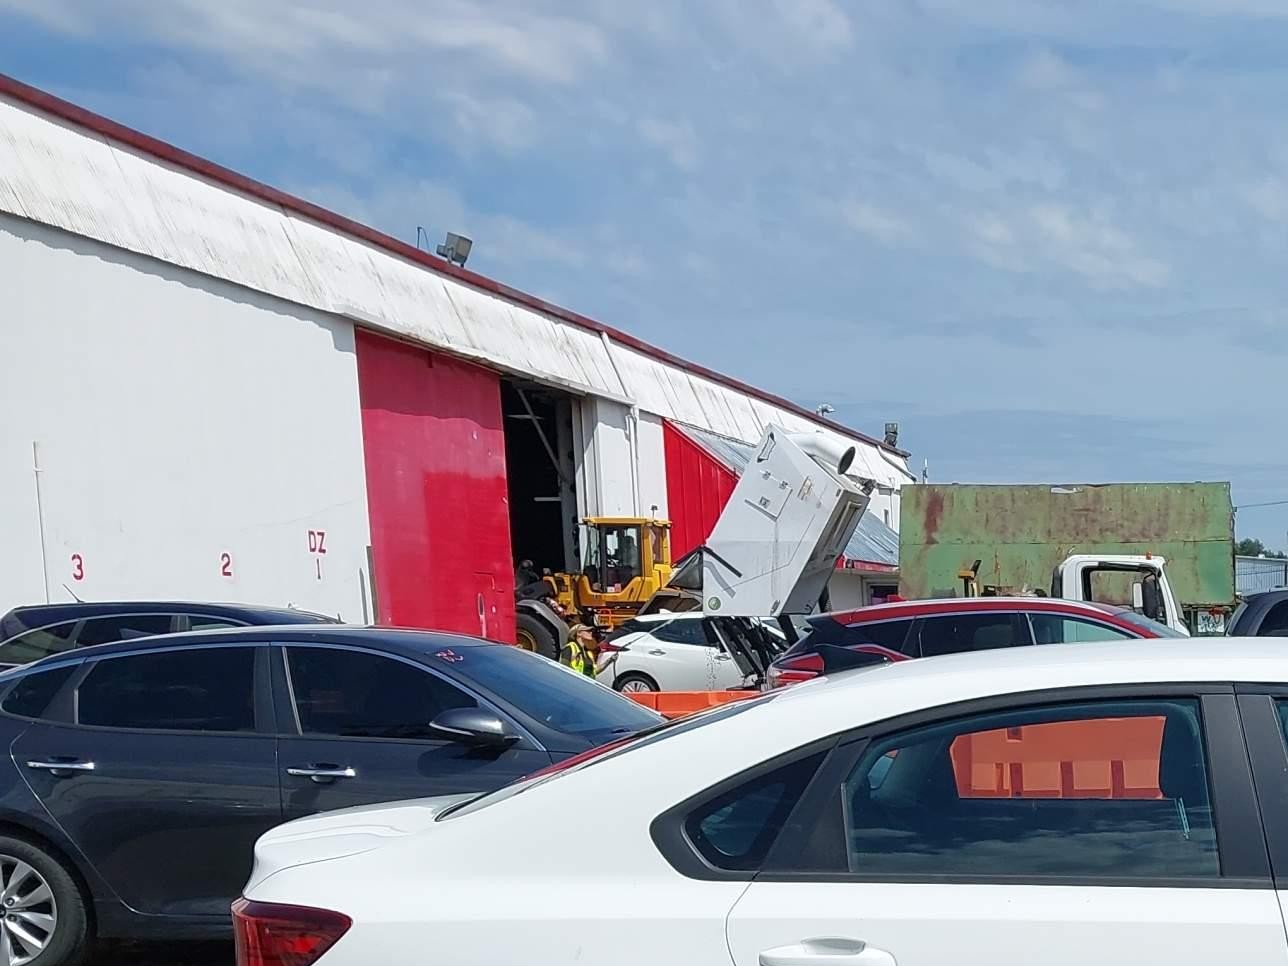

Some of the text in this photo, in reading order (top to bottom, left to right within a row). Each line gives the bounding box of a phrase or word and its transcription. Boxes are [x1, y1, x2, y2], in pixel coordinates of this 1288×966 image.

[308, 530, 327, 553] DZ
[71, 553, 84, 581] 3
[221, 553, 232, 576] 2
